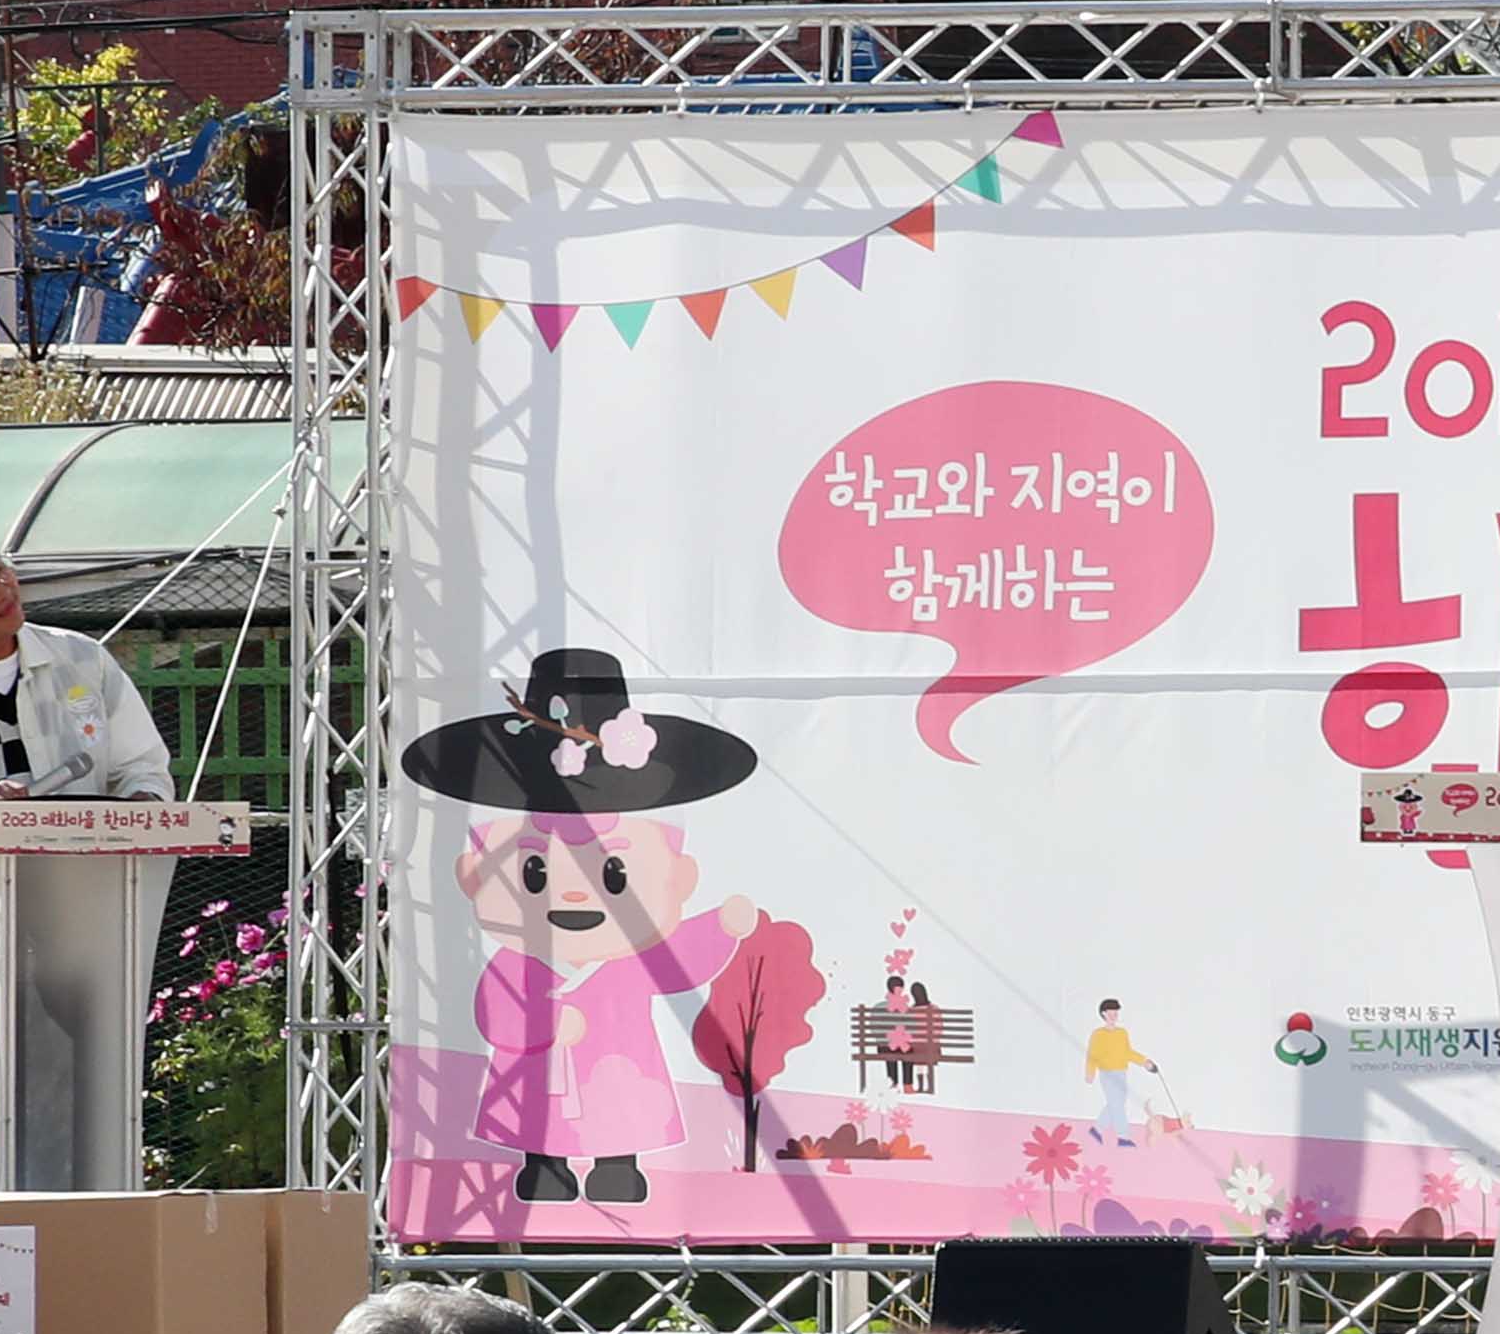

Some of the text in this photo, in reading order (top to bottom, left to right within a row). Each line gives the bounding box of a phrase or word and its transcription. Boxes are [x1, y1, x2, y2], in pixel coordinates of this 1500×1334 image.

[824, 450, 1177, 527] 학교와 지역이
[883, 543, 1116, 622] 함께하는
[1, 810, 38, 827] 2023
[41, 810, 96, 830] 매화마을
[103, 810, 155, 831] 한마당
[157, 810, 190, 830] 축제
[1346, 1006, 1457, 1022] 인천광역시 동구
